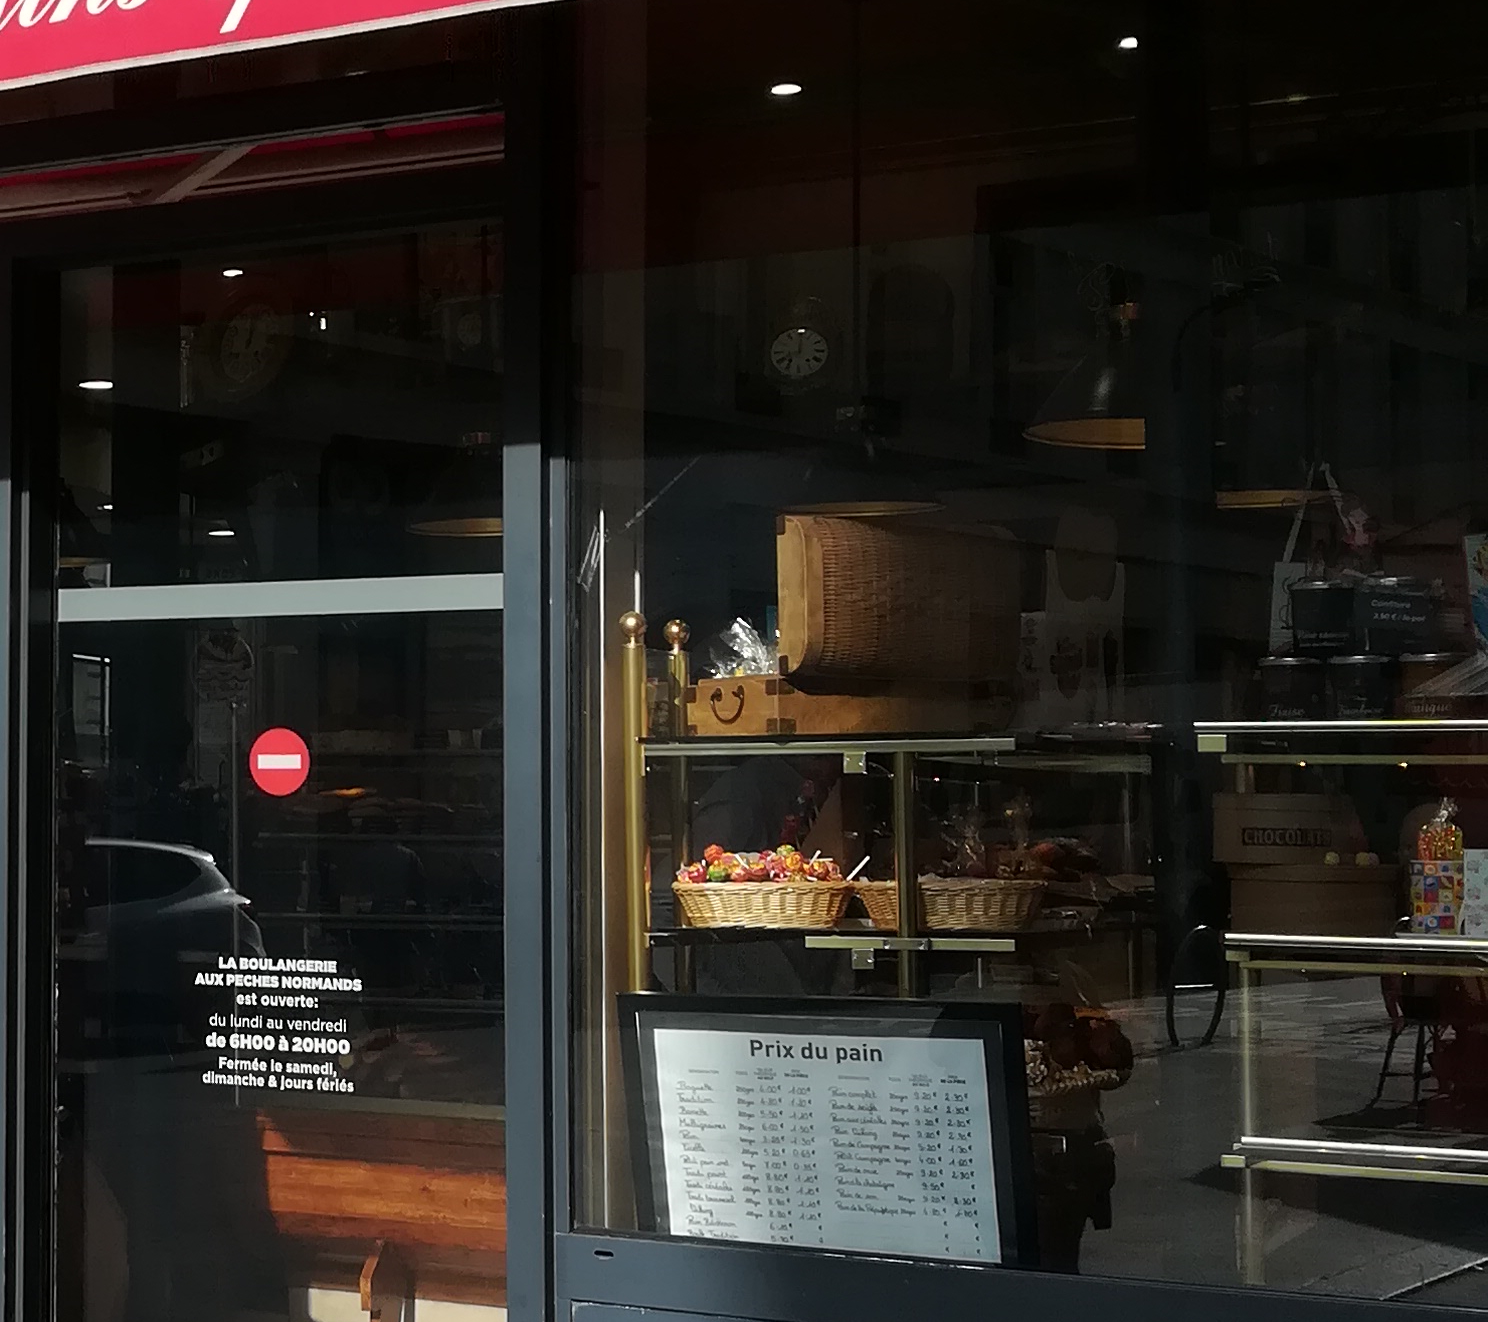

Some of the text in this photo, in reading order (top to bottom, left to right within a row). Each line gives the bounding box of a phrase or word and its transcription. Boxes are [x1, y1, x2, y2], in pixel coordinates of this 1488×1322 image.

[218, 956, 338, 973] LA BOULANGERIE
[195, 972, 363, 993] AUX PECHES NORMANDS
[236, 992, 319, 1009] est ouverte:
[209, 1012, 348, 1033] du lundi au vendredi
[205, 1032, 351, 1055] de 6H00 à 20H00
[750, 1039, 883, 1064] Prix du pain
[218, 1056, 338, 1077] Fermée le samedi,
[202, 1071, 355, 1093] dimanche & jours fériés
